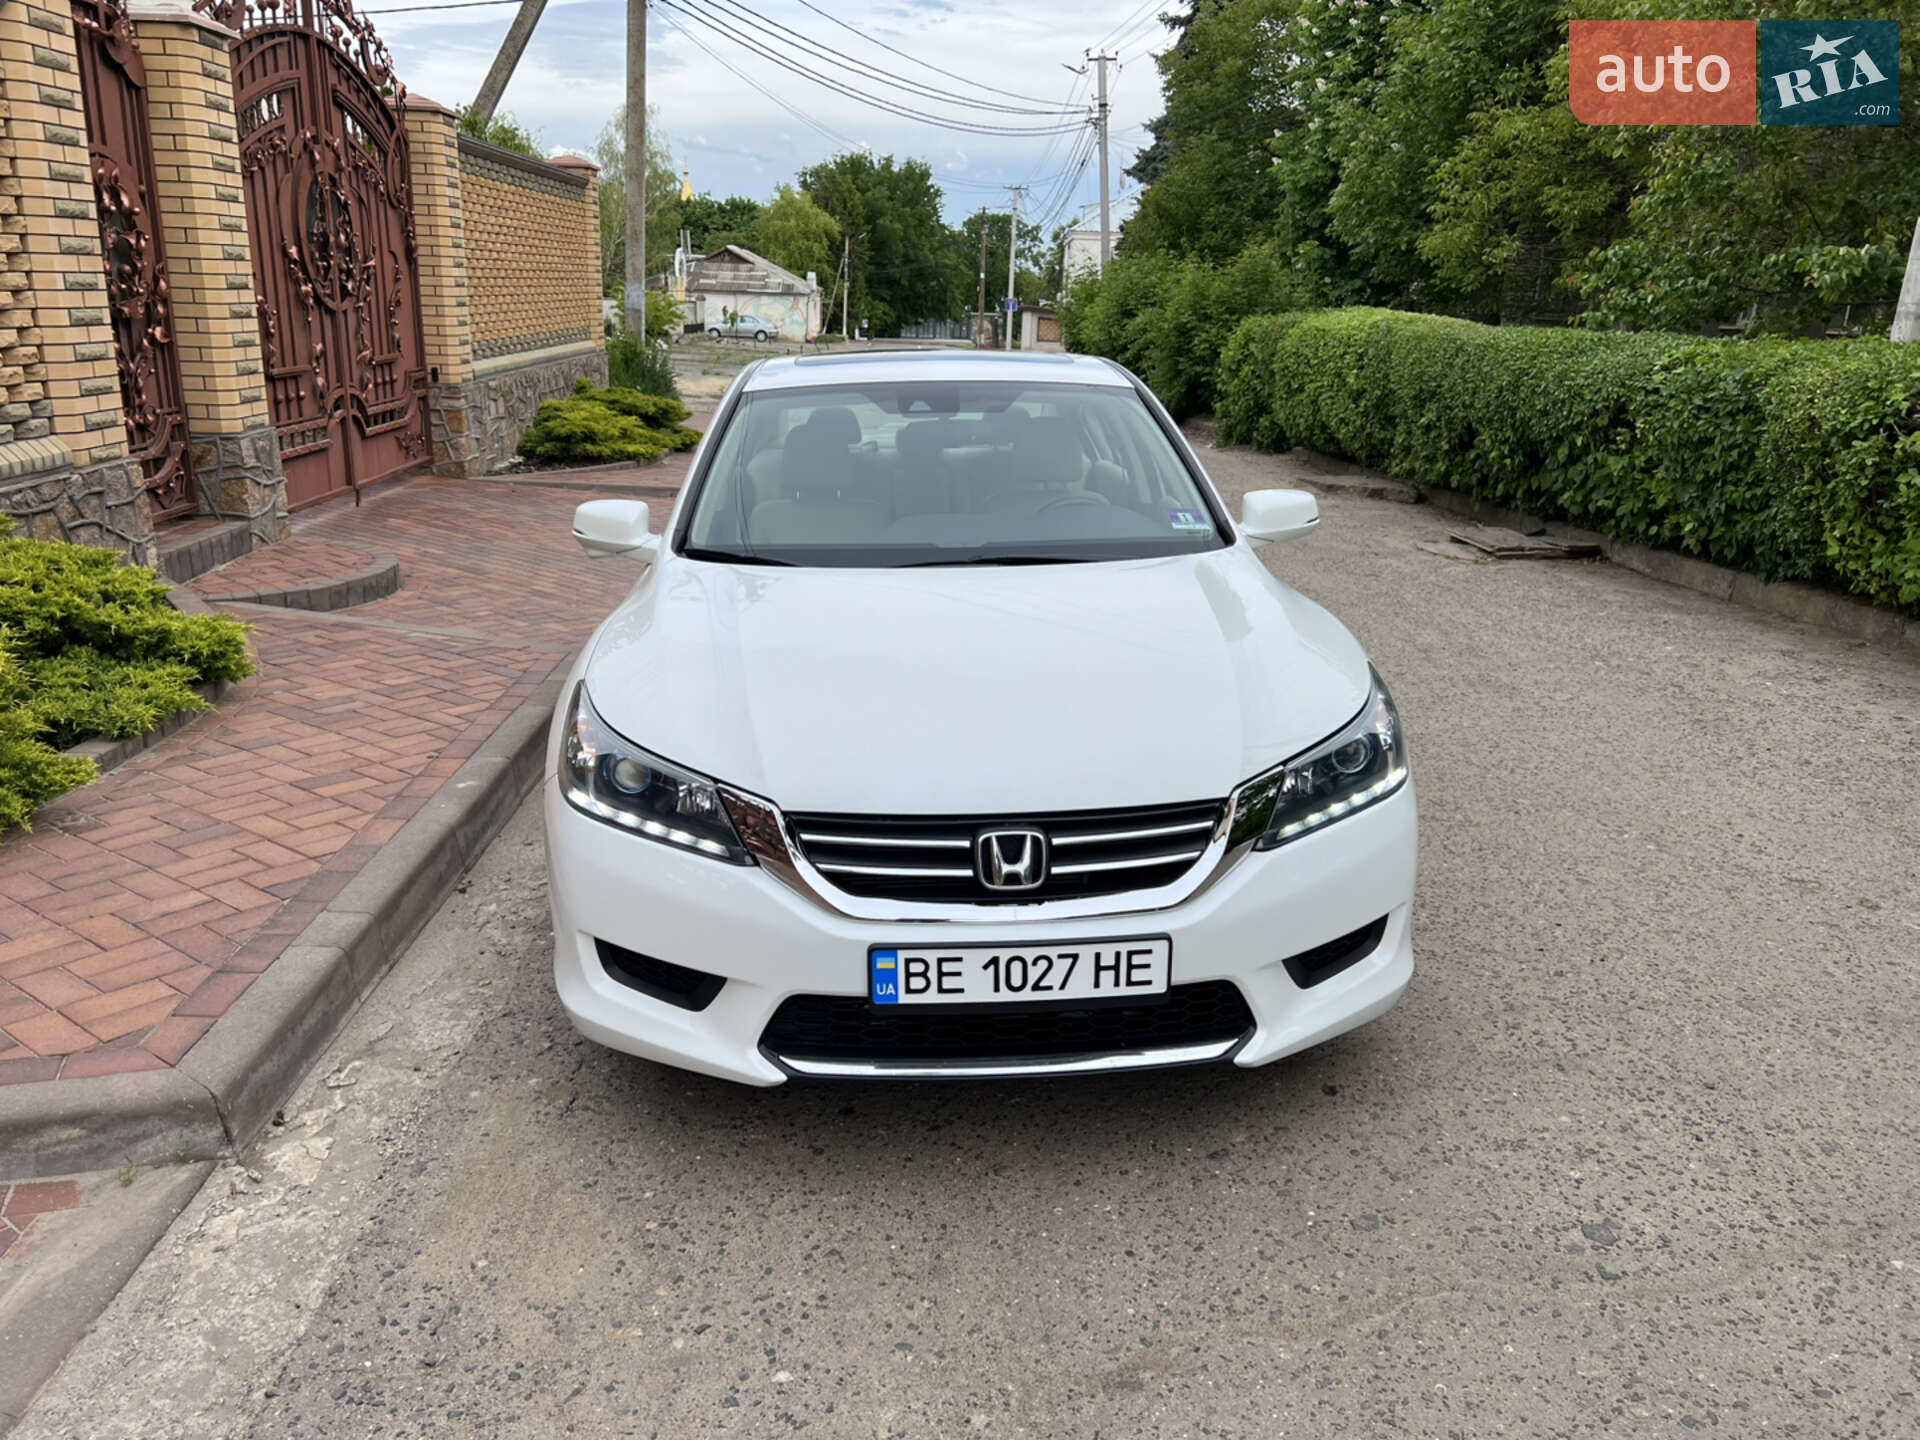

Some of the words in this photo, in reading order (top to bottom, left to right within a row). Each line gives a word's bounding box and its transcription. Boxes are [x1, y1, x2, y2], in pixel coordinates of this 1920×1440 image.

[904, 956, 965, 994] BE
[981, 953, 1080, 993] 1027
[1093, 949, 1153, 989] HE
[876, 983, 896, 995] UA
